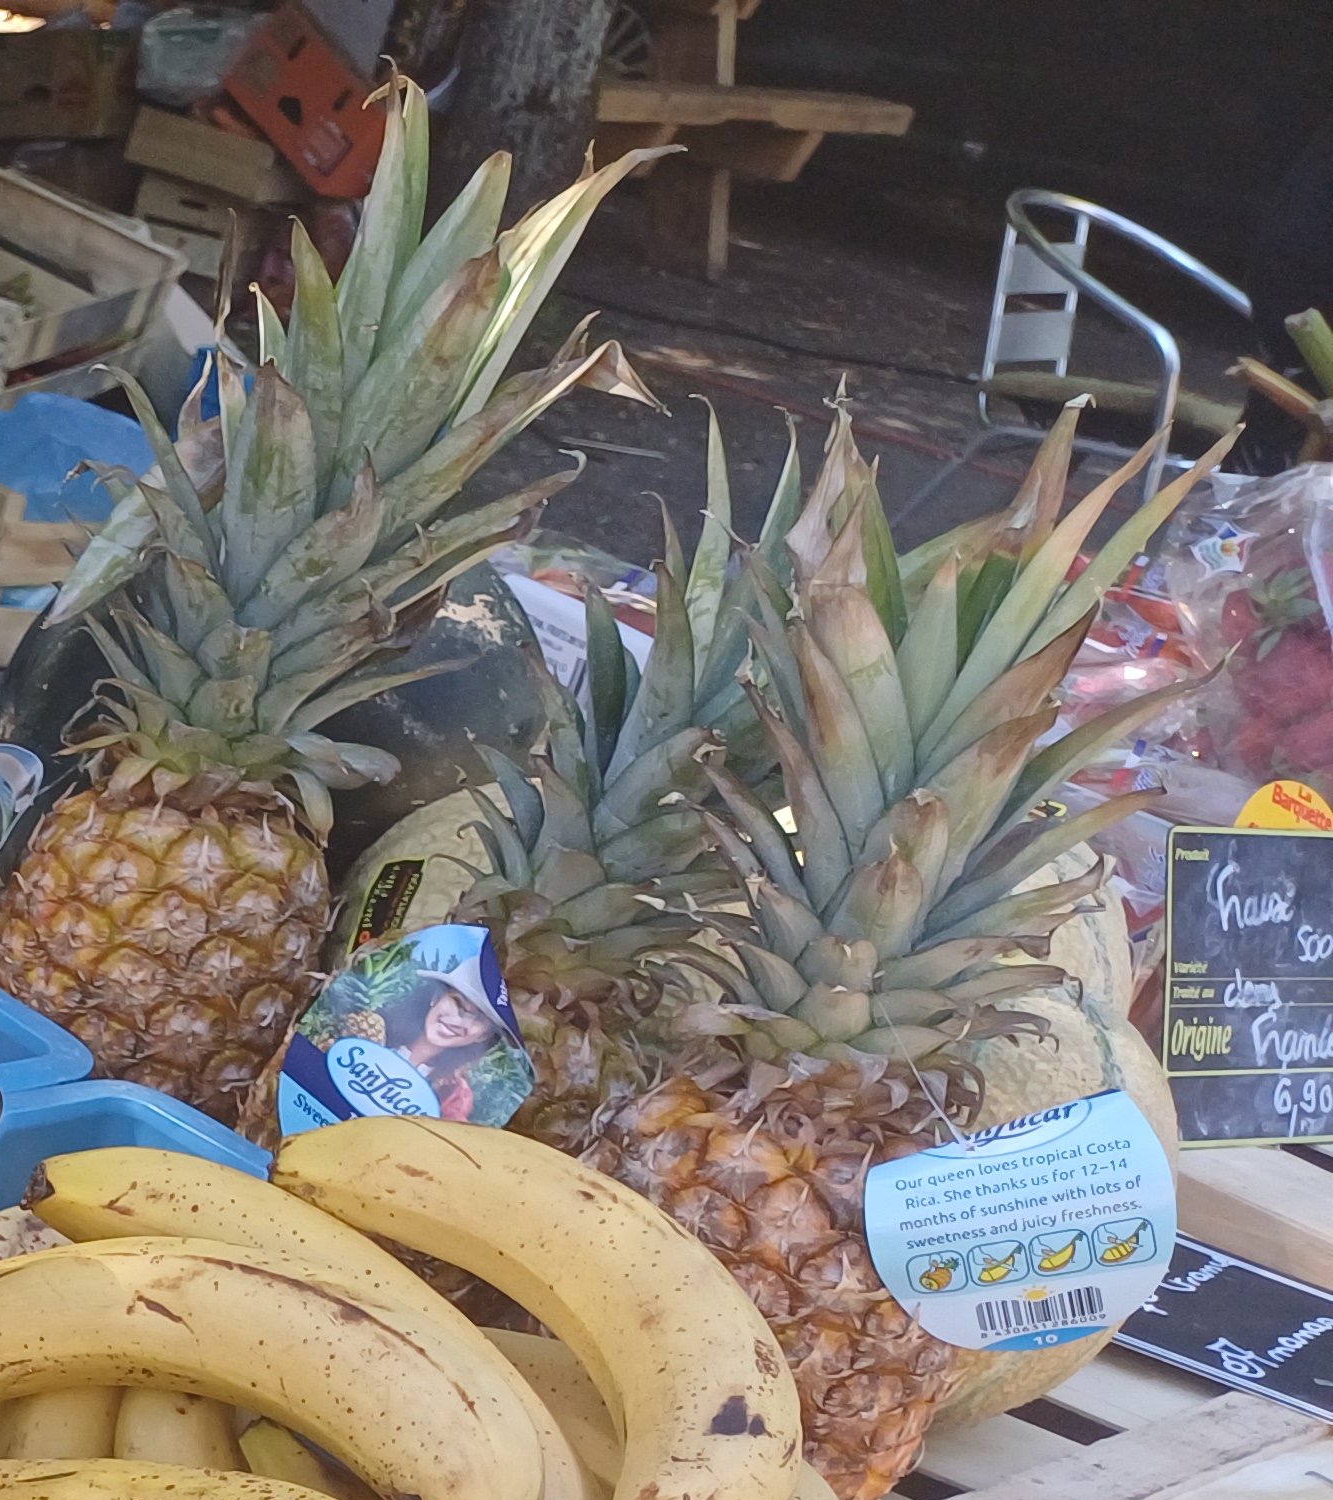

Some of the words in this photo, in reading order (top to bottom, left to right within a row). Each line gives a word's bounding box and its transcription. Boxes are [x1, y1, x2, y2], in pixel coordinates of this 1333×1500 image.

[1172, 1016, 1232, 1061] Origine
[895, 1177, 923, 1192] Our
[928, 1166, 975, 1189] queen
[978, 1159, 1019, 1176] loves
[1022, 1145, 1083, 1171] tropical
[1087, 1138, 1131, 1157] Costa
[900, 1213, 957, 1232] months
[960, 1206, 978, 1221] of
[980, 1196, 1048, 1218] sunshine
[1051, 1187, 1087, 1204] with
[1090, 1181, 1122, 1197] lots
[1125, 1175, 1142, 1191] of
[905, 1195, 940, 1211] Rica.
[943, 1187, 972, 1203] She
[976, 1177, 1028, 1197] thanks
[1031, 1175, 1049, 1187] us
[1052, 1168, 1076, 1183] for
[906, 1229, 987, 1251] sweetness
[989, 1219, 1018, 1236] and
[1021, 1214, 1057, 1234] juicy
[1061, 1199, 1143, 1223] freshness.
[1033, 1333, 1059, 1347] 10
